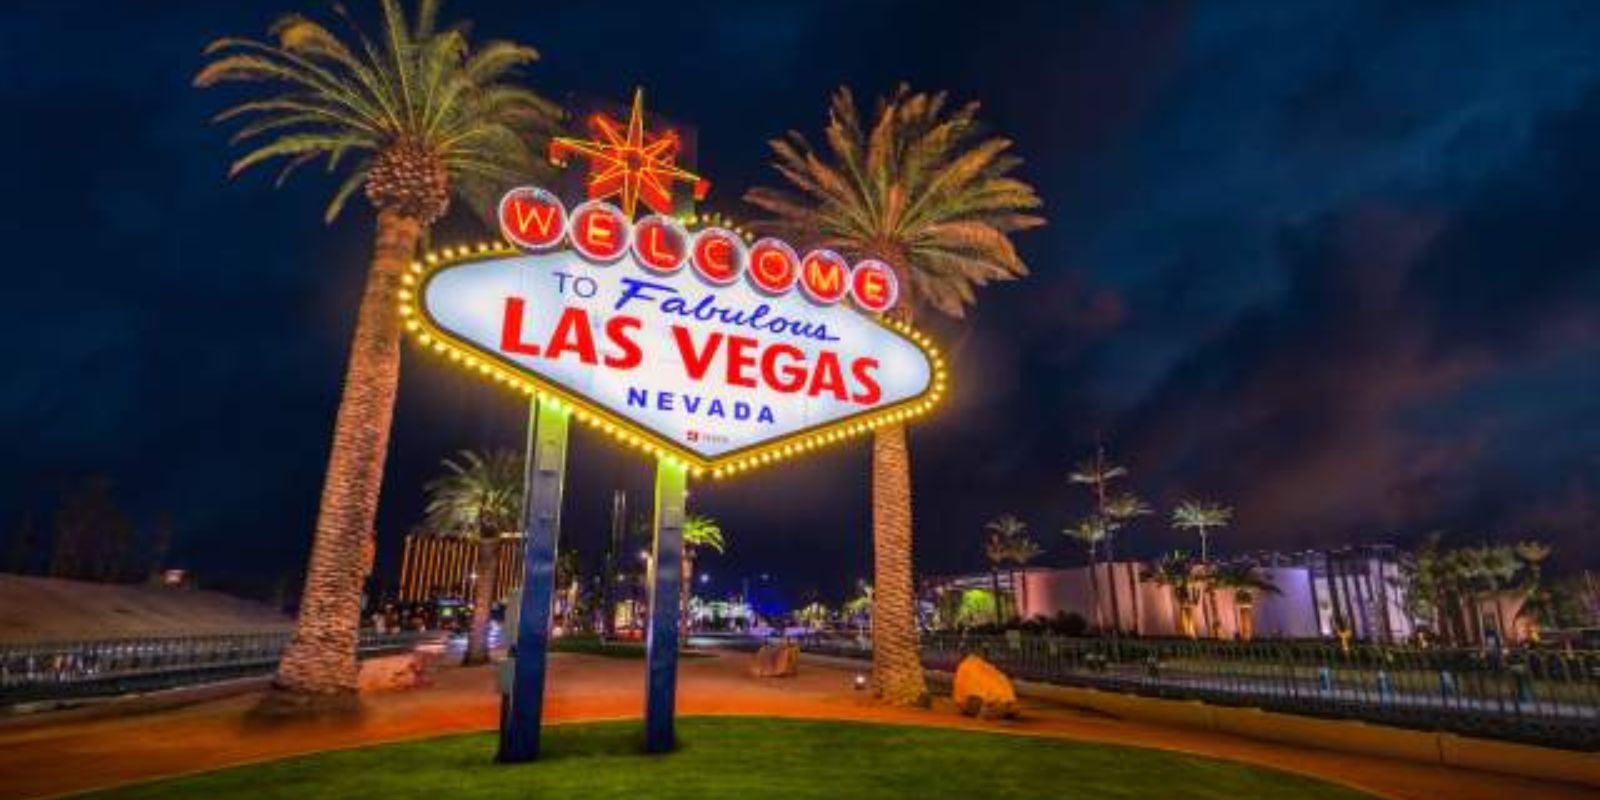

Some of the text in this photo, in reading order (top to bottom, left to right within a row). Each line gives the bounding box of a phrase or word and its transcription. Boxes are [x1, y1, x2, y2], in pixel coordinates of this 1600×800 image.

[514, 200, 888, 301] WELCOME
[553, 272, 841, 342] TO Fabulous
[500, 297, 882, 405] LAS VEGAS
[627, 387, 776, 424] NEVADA
